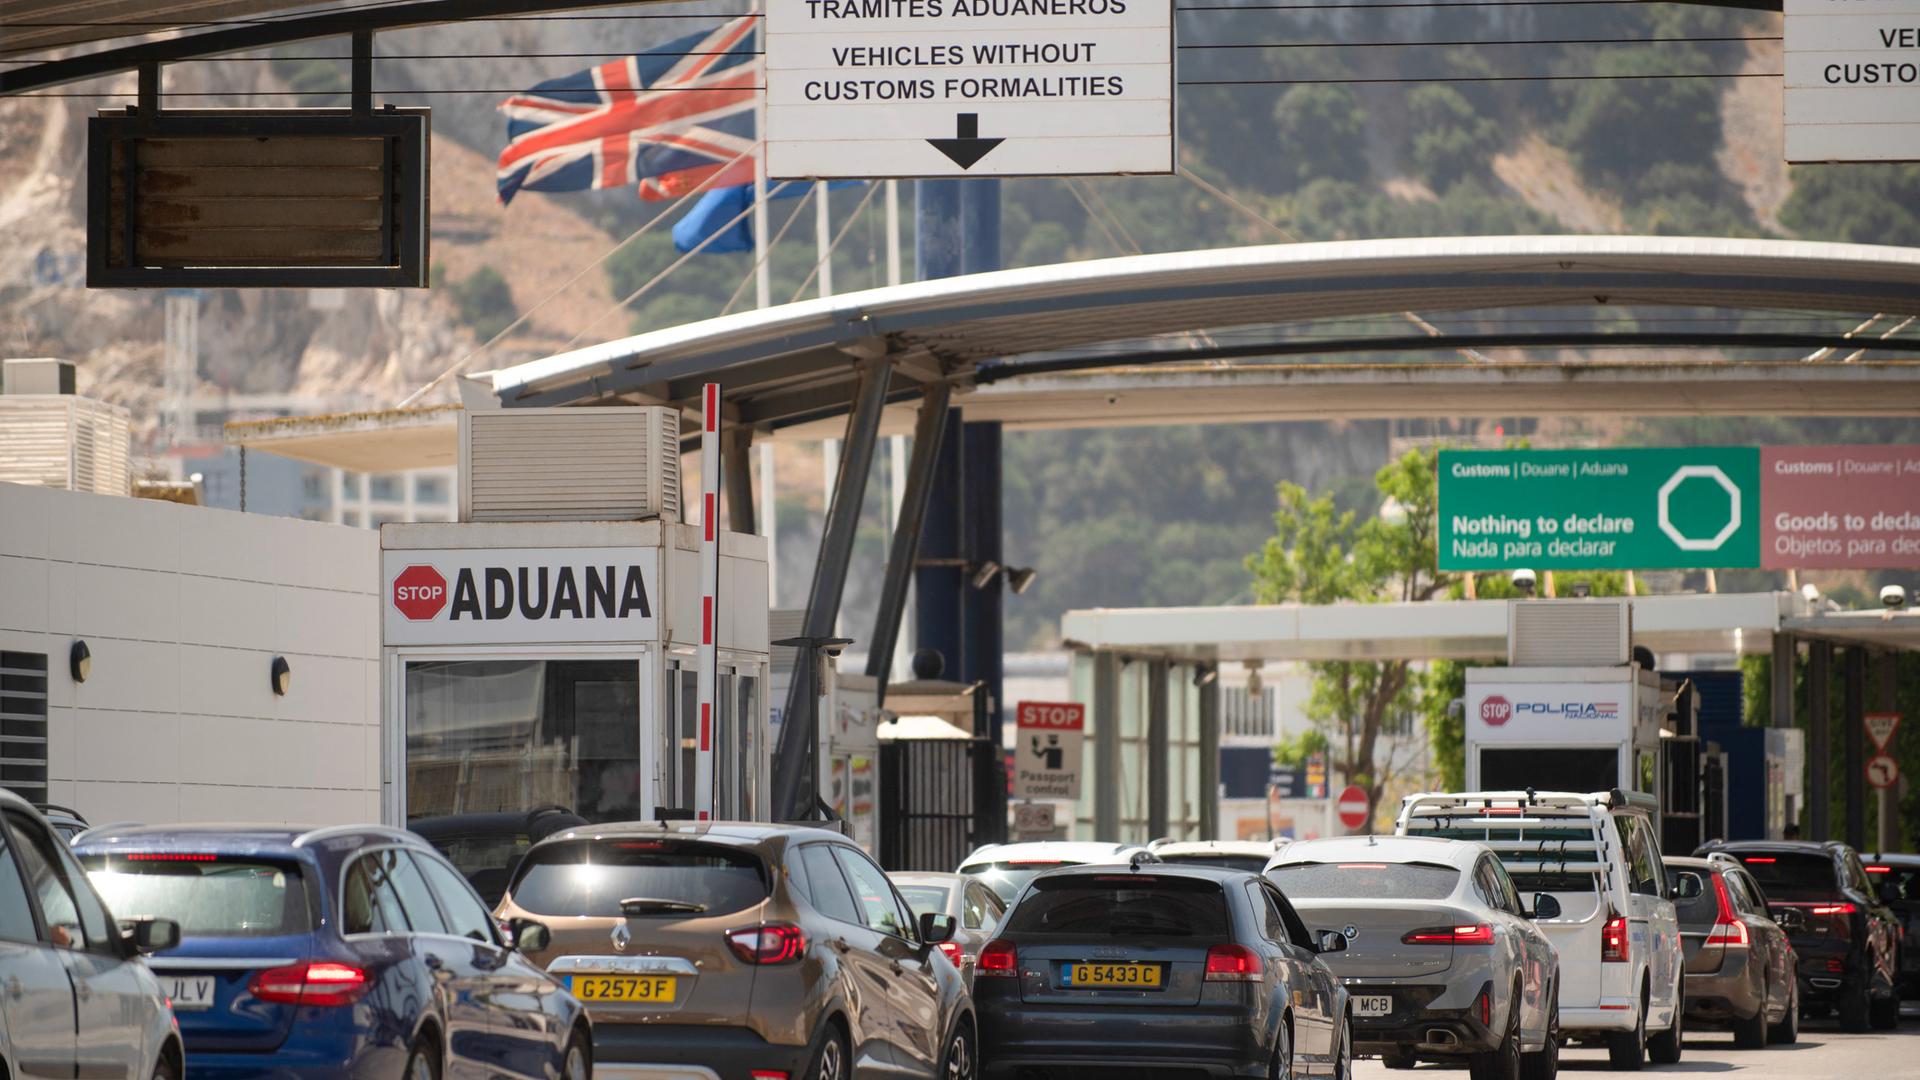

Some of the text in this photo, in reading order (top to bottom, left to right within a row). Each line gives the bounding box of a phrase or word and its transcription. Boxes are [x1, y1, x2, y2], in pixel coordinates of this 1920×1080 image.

[805, 0, 1127, 19] TRAMITES ADUANEROS
[1879, 28, 1920, 48] VE
[832, 43, 1097, 66] VEHICLES WITHOUT
[1824, 63, 1920, 84] CUSTO
[804, 76, 1124, 101] CUSTOMS FORMALITIES
[1452, 463, 1510, 478] Customs
[1521, 462, 1570, 476] Douane
[1580, 461, 1629, 476] Aduana
[1775, 460, 1834, 474] Customs
[1845, 460, 1893, 474] Douane
[1453, 513, 1634, 538] Nothing to declare
[1775, 511, 1839, 531] Goods
[1844, 513, 1865, 531] to
[1453, 537, 1616, 561] Nada para declarar
[1775, 535, 1842, 558] Objetos
[1847, 539, 1886, 558] para
[398, 565, 652, 620] STOP ADUANA
[1024, 706, 1080, 725] STOP
[1483, 703, 1598, 719] STOP POLICIA
[1565, 712, 1619, 720] NACIONAL
[1020, 771, 1075, 784] Passport
[1025, 784, 1069, 795] control
[1361, 998, 1389, 1012] MCB
